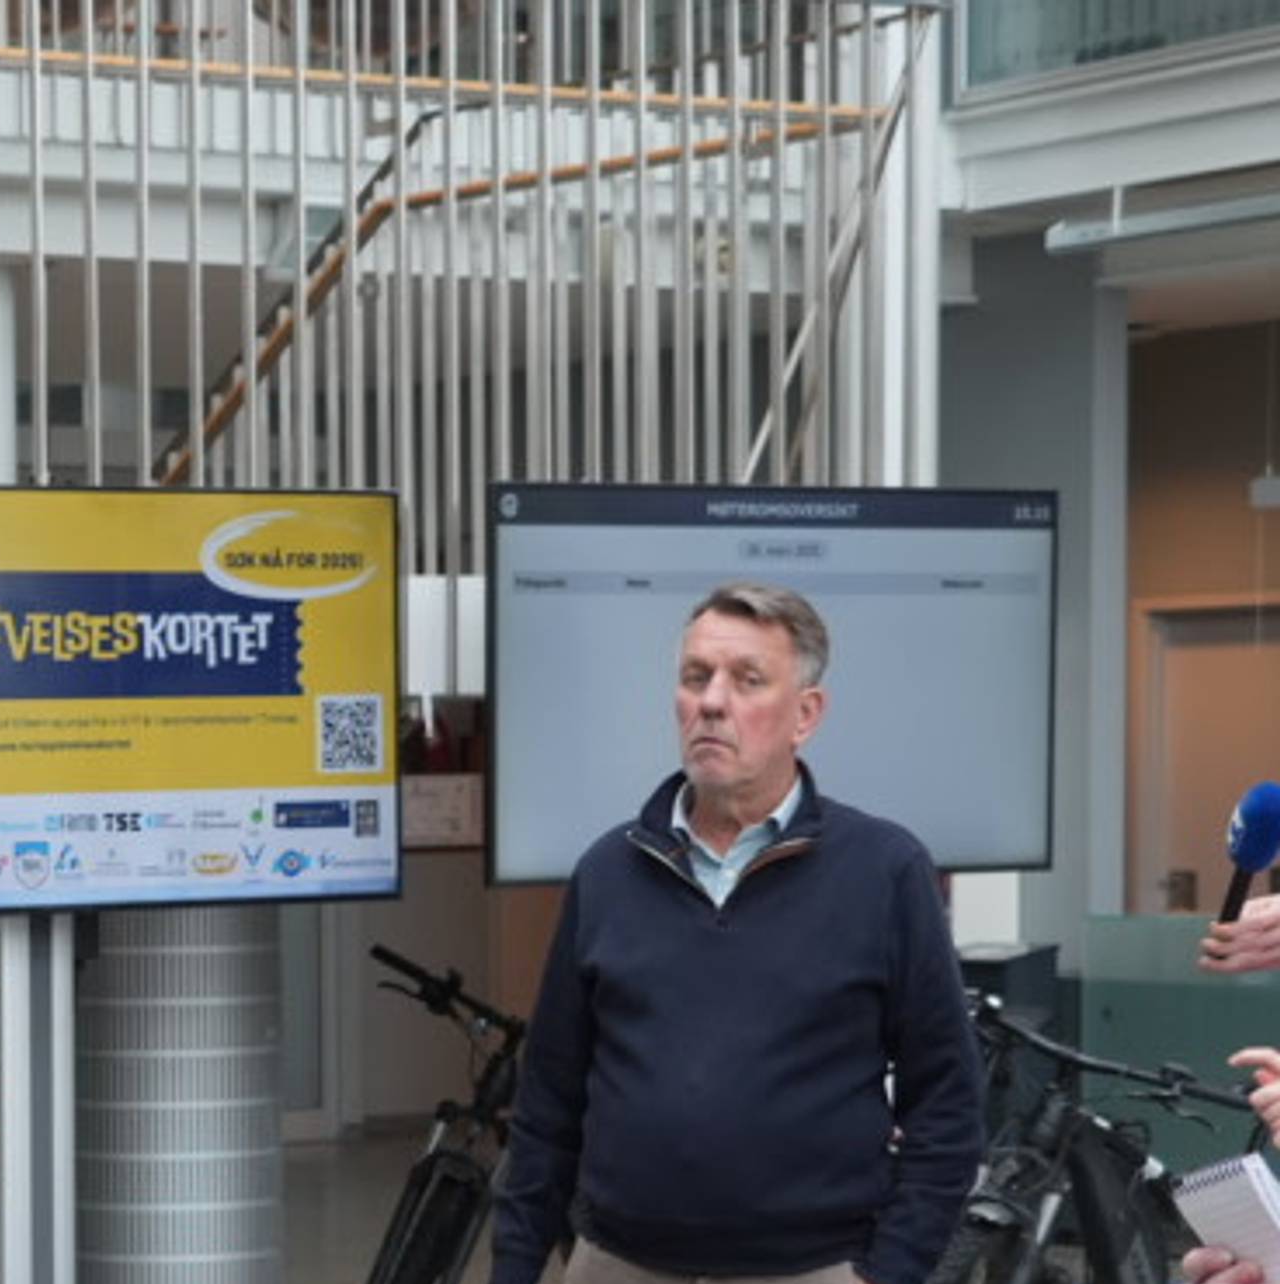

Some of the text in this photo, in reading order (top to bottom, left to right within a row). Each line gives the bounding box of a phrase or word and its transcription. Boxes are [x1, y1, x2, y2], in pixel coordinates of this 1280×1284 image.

[260, 547, 283, 569] NÅ
[287, 552, 317, 569] FOR
[102, 812, 142, 832] TSE
